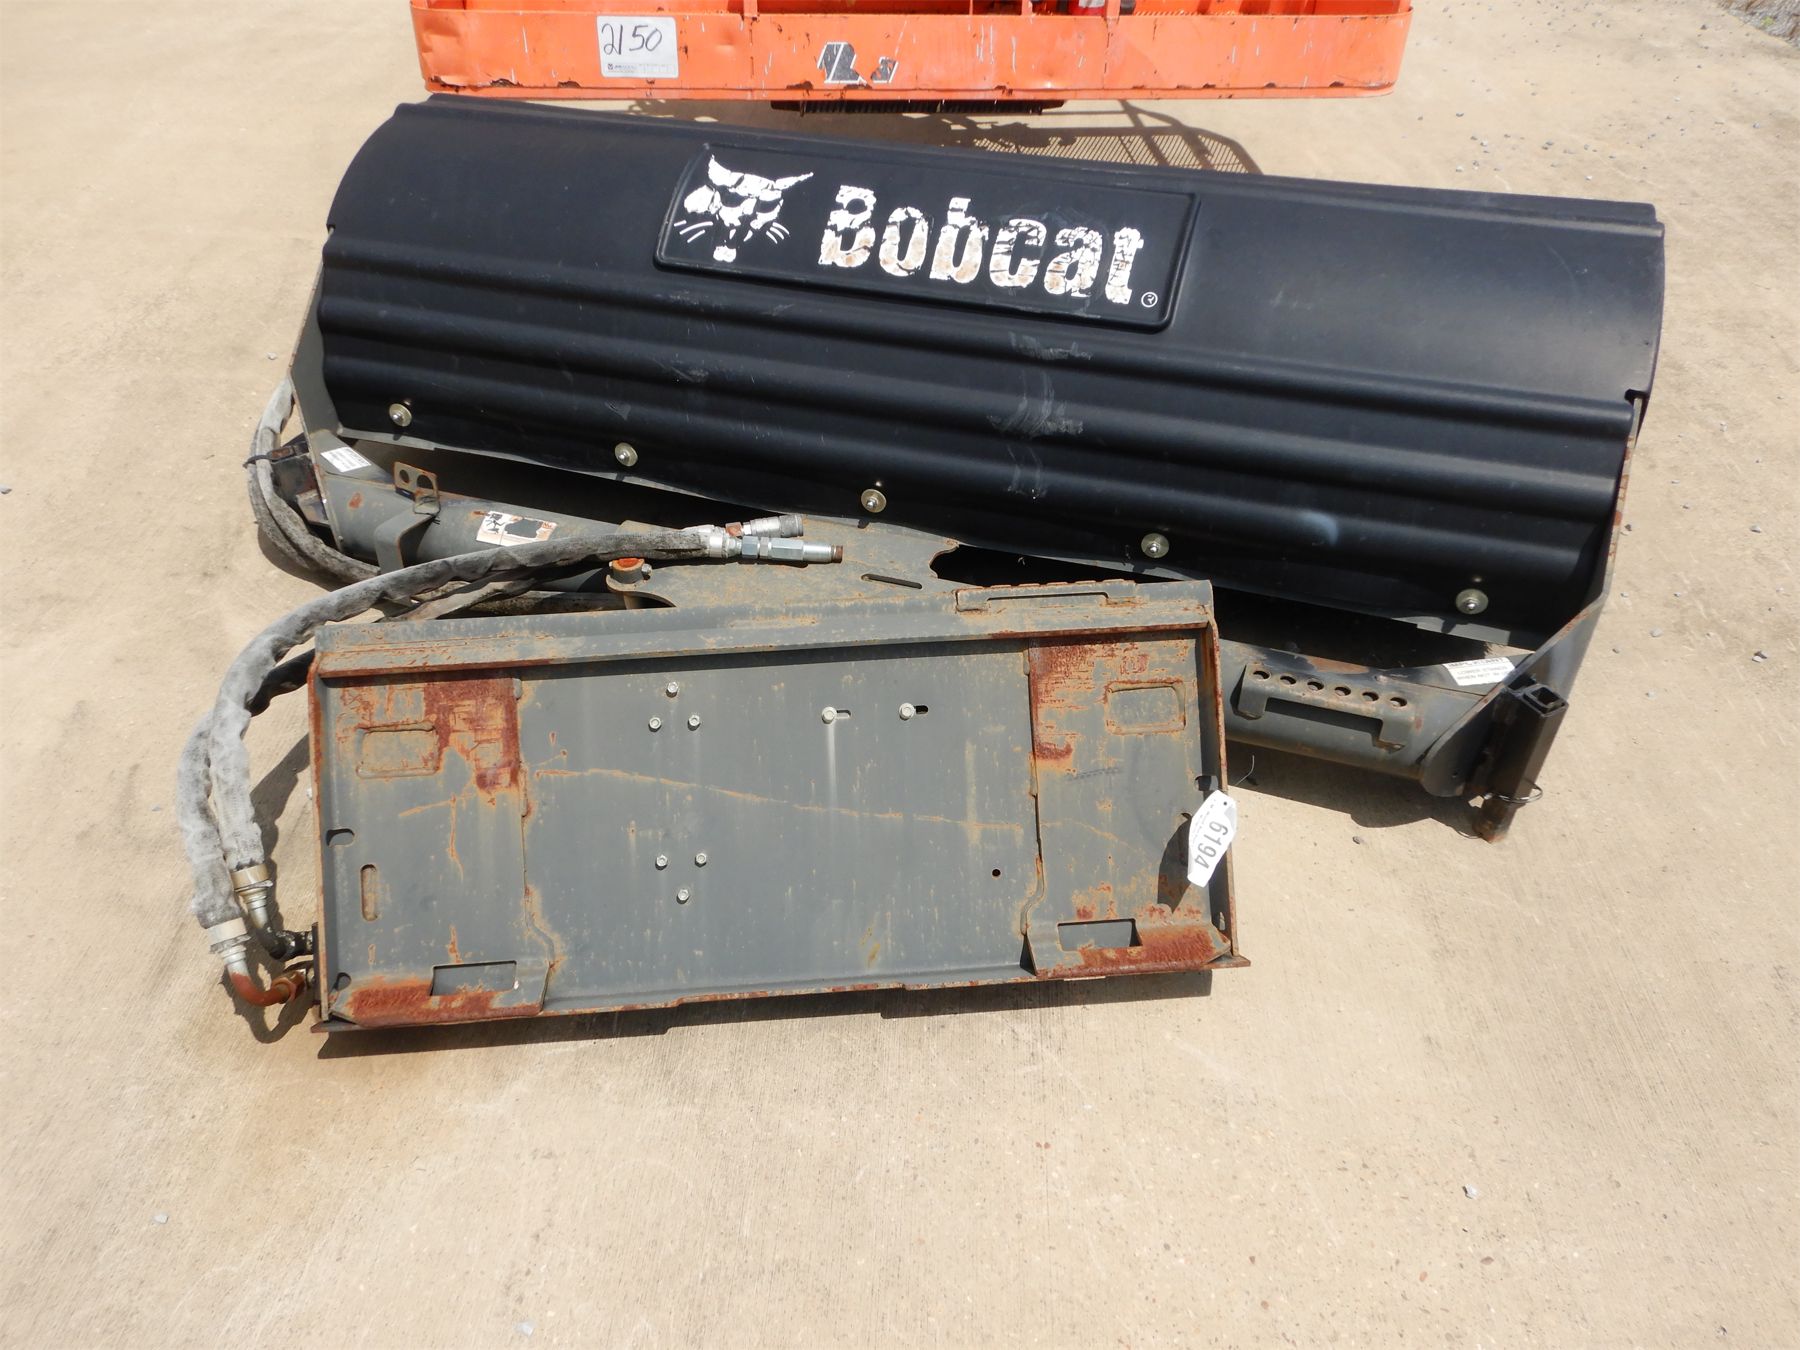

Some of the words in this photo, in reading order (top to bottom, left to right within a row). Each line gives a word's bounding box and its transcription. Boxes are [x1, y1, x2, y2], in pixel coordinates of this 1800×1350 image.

[601, 23, 663, 55] 2150
[817, 184, 1145, 305] Bobcat
[1194, 820, 1229, 869] 6194
